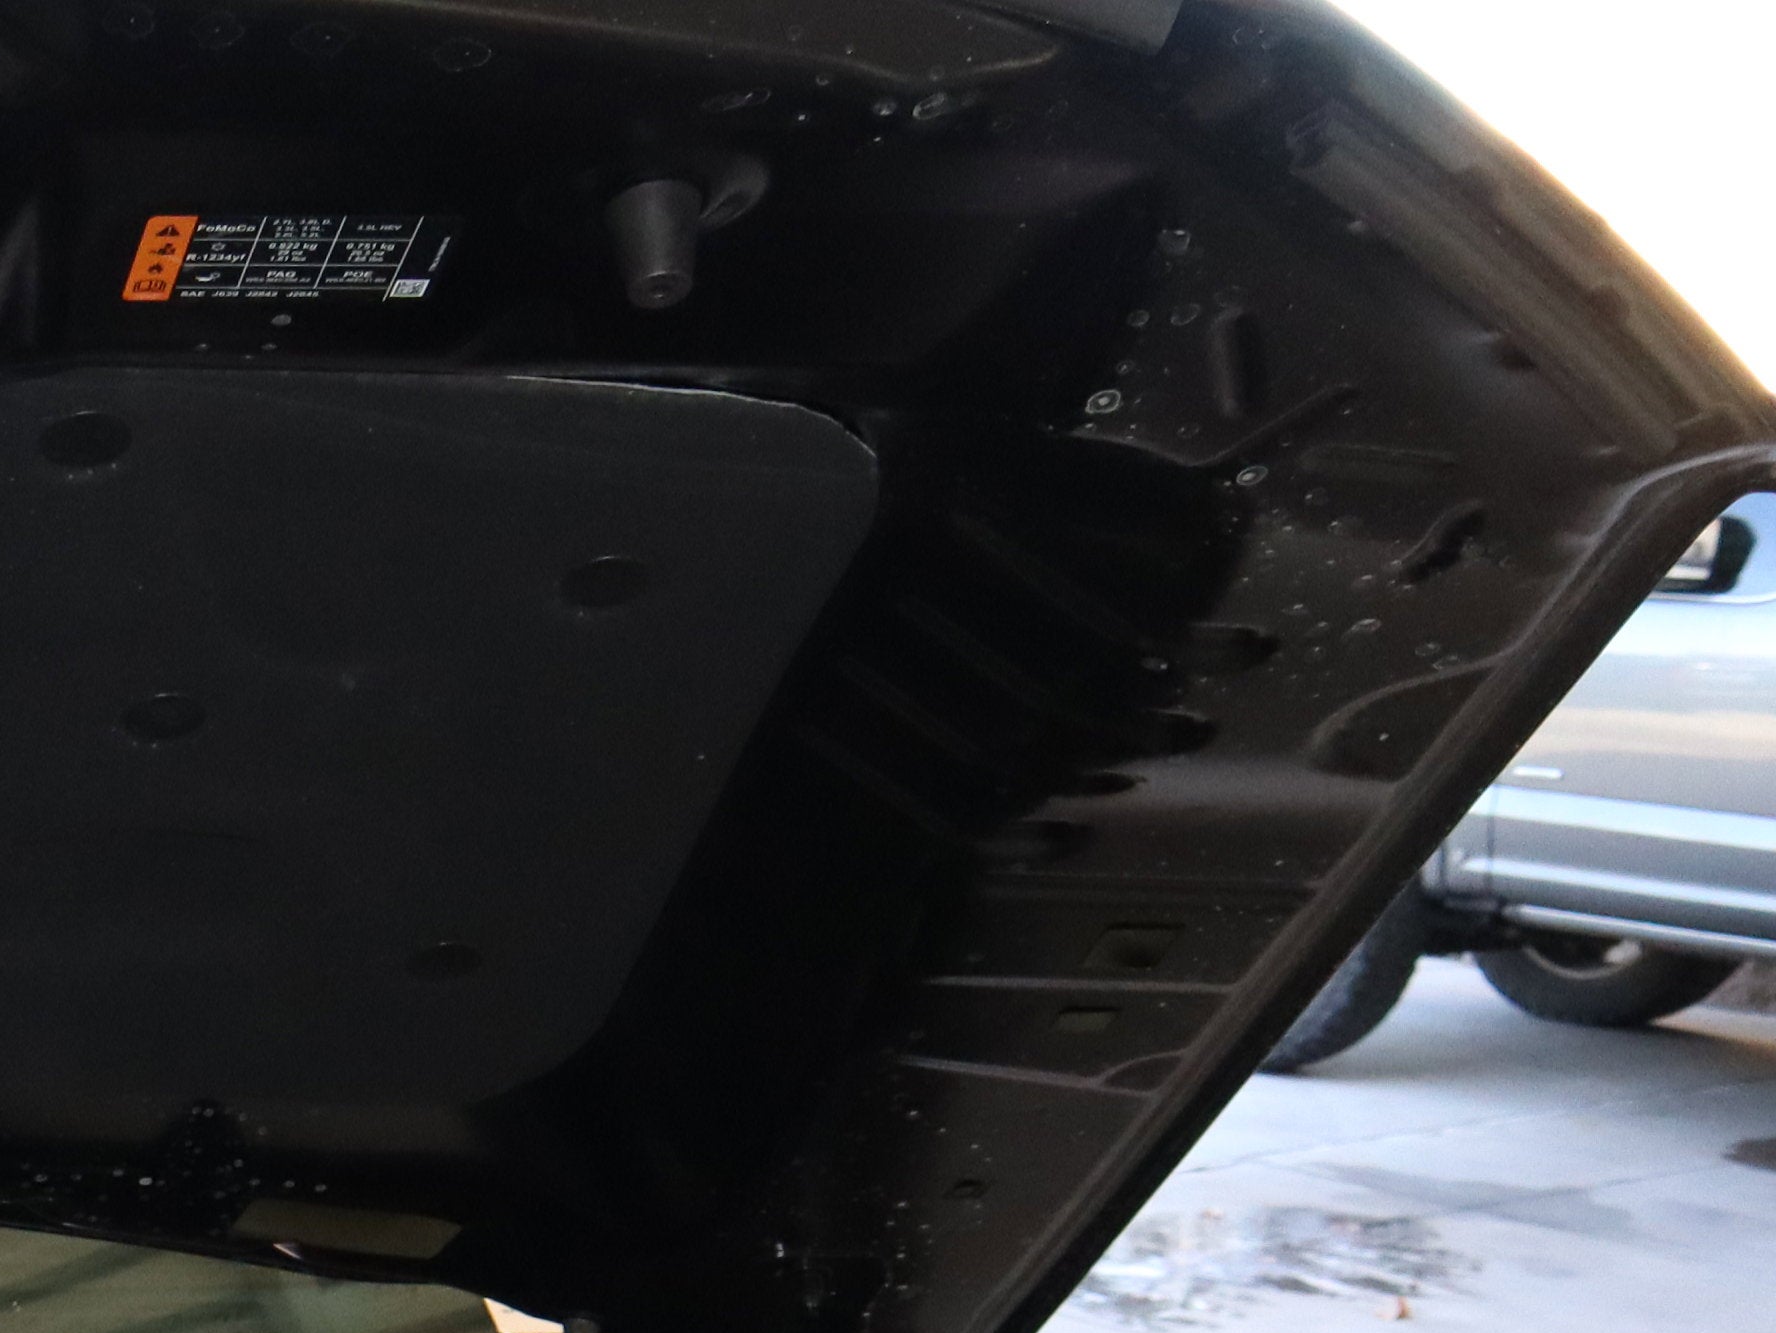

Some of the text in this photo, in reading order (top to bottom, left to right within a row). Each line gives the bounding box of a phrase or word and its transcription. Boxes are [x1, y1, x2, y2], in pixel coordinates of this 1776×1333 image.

[197, 224, 257, 233] FoMoCo
[303, 243, 319, 252] kg
[380, 243, 395, 252] kg
[186, 253, 247, 264] R-1234yf
[266, 270, 296, 278] PAG
[343, 270, 374, 278] POE
